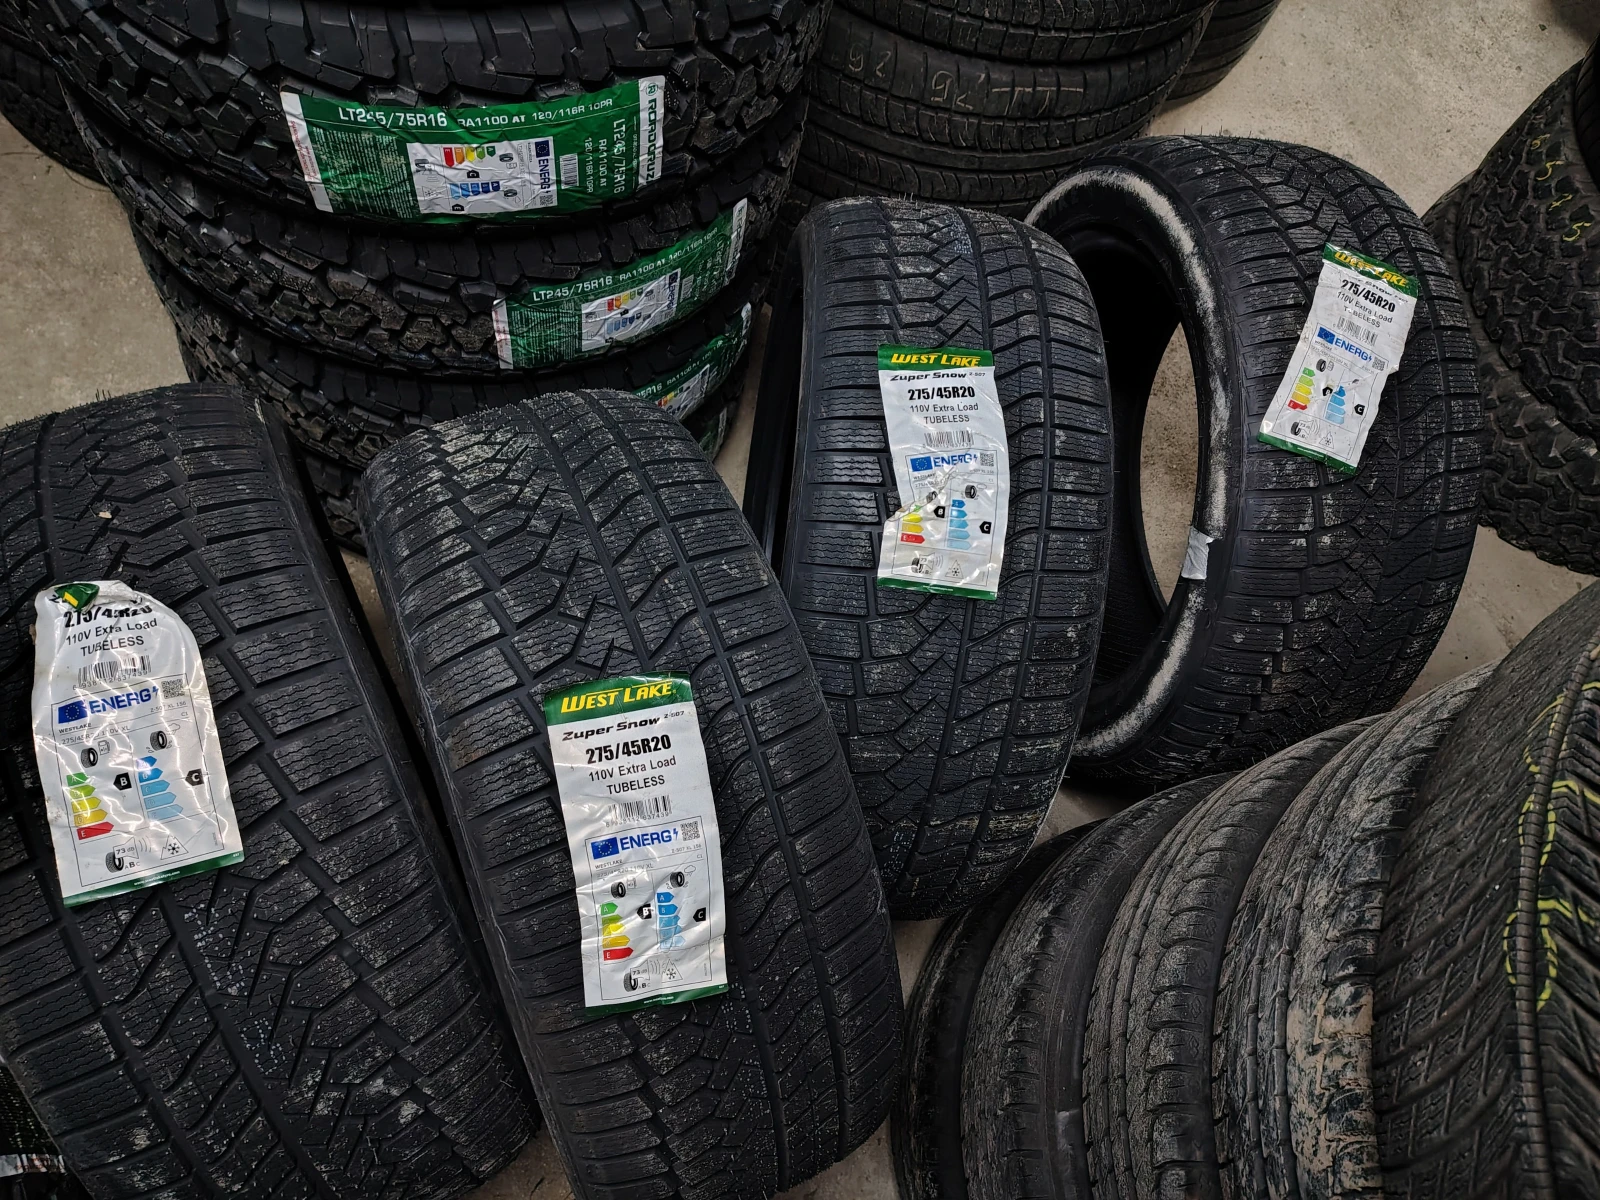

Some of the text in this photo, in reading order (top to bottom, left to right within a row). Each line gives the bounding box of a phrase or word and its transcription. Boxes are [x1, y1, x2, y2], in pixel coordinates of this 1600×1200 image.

[339, 98, 612, 128] LT245/75R16 RA1100 AT 120/116R 10PR
[646, 98, 657, 184] ROADCRUZ
[539, 158, 550, 190] ENERG
[533, 276, 612, 301] LT245/75R16
[620, 263, 654, 280] RA1100
[1375, 268, 1408, 287] LAKE
[1337, 291, 1393, 323] 110V Extra Load
[1341, 279, 1395, 313] 275/45R20
[891, 353, 981, 367] WEST LAKE
[1334, 338, 1369, 361] ENERG
[890, 374, 930, 382] Zuper
[907, 386, 975, 400] 275/45R20
[910, 403, 979, 413] 110V Extra Load
[924, 415, 970, 424] TUBELESS
[66, 629, 91, 646] 110V
[127, 618, 158, 631] Load
[80, 635, 144, 657] TUBELESS
[88, 689, 150, 714] ENERG
[561, 679, 673, 713] WEST LAKE
[59, 723, 92, 733] WESTLAKE
[562, 725, 614, 741] Zuper
[616, 717, 661, 731] Snow
[585, 734, 671, 764] 275/45R20
[192, 773, 199, 781] C
[588, 755, 676, 781] 110V Extra Load
[120, 778, 128, 787] B
[606, 775, 665, 795] TUBELESS
[620, 829, 672, 850] ENERG
[116, 847, 126, 855] 73
